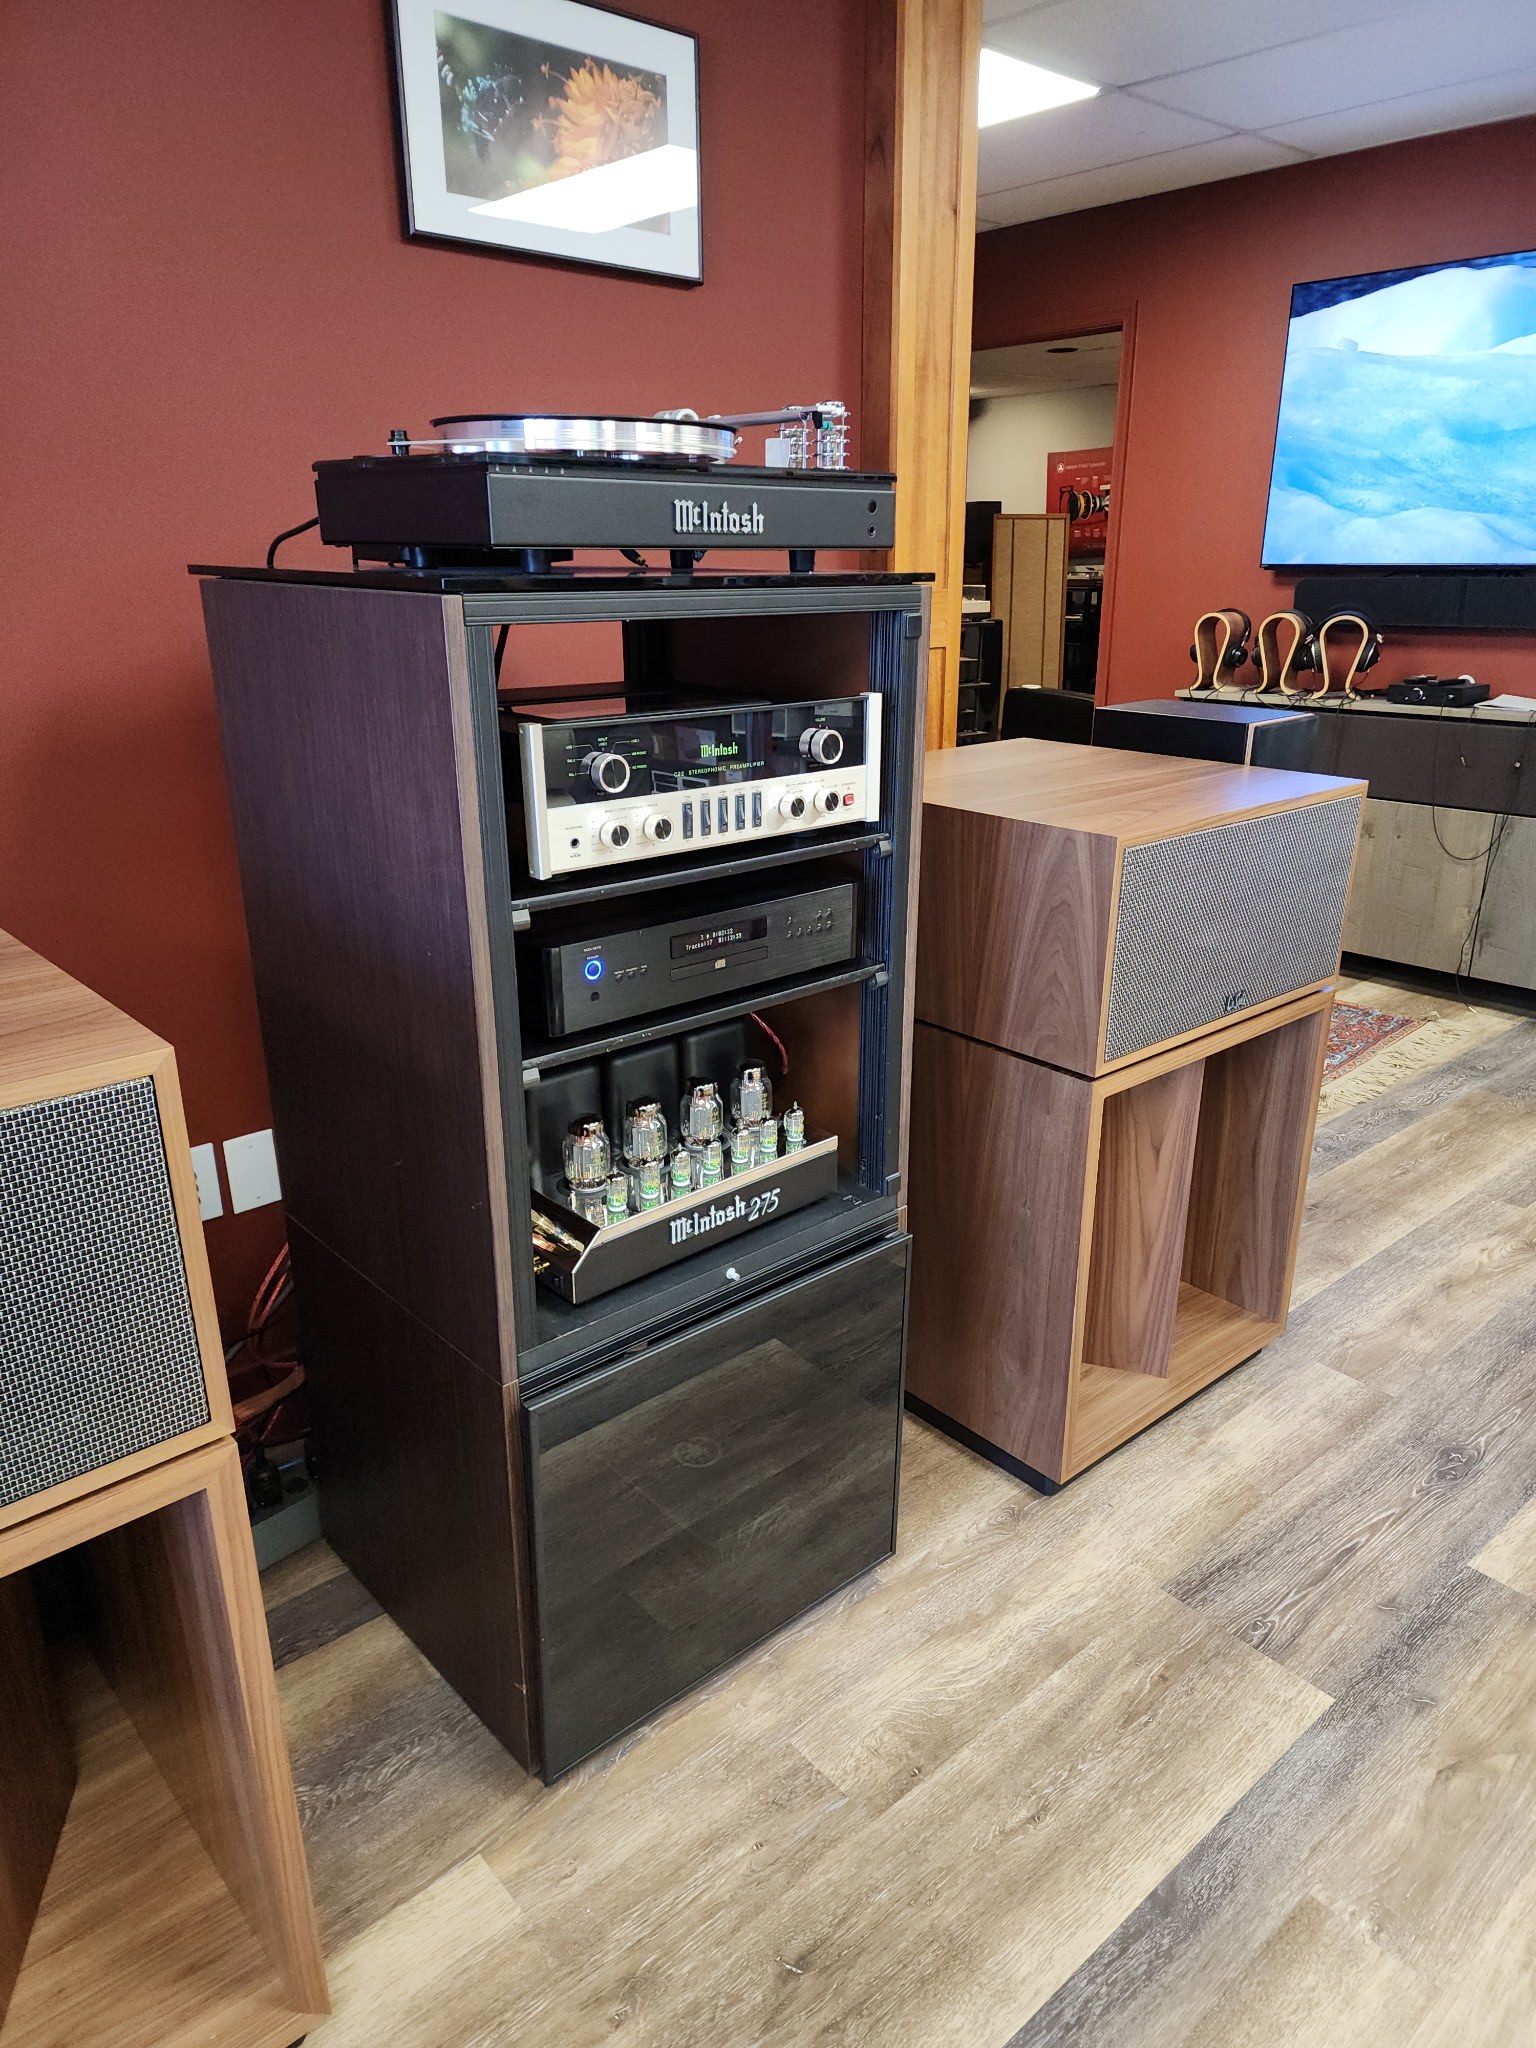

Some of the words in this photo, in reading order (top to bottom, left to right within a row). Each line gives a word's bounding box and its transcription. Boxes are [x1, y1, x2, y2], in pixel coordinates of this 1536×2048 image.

[673, 498, 765, 534] McIntosh
[700, 741, 739, 758] McIntosh
[673, 770, 685, 778] C22
[688, 765, 727, 776] STEREOPHONIC
[729, 760, 765, 771] PREAMPLIFIER
[669, 1194, 747, 1245] McIntosh
[747, 1187, 781, 1222] 275
